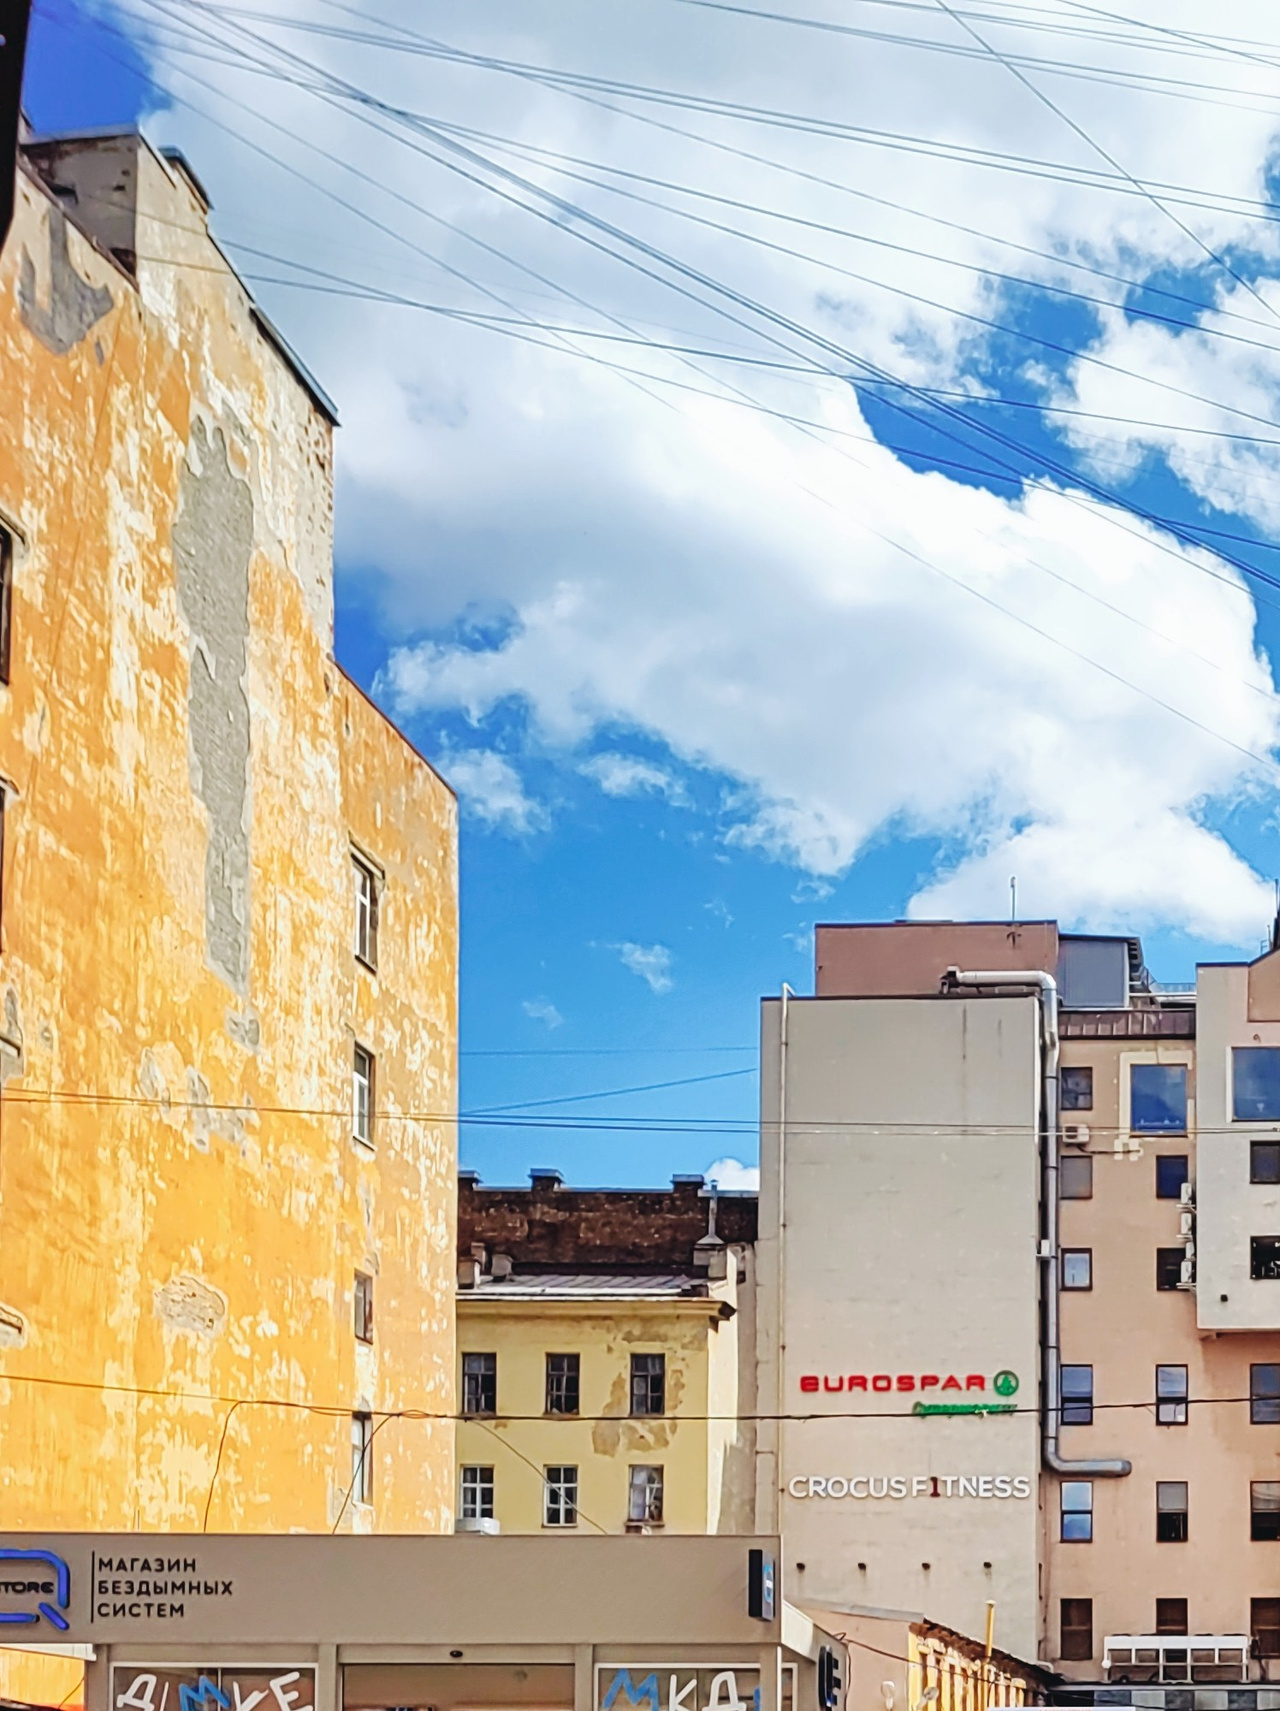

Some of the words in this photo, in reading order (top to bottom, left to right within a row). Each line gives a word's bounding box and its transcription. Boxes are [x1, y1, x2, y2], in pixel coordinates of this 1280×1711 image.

[800, 1375, 986, 1392] EUROSPAR
[789, 1475, 907, 1499] CROCUS
[98, 1557, 196, 1573] МАГАЗИН
[0, 1581, 54, 1595] TORE
[98, 1580, 233, 1597] БЕЗДЫМНЫХ
[97, 1603, 184, 1618] СИСТЕМ
